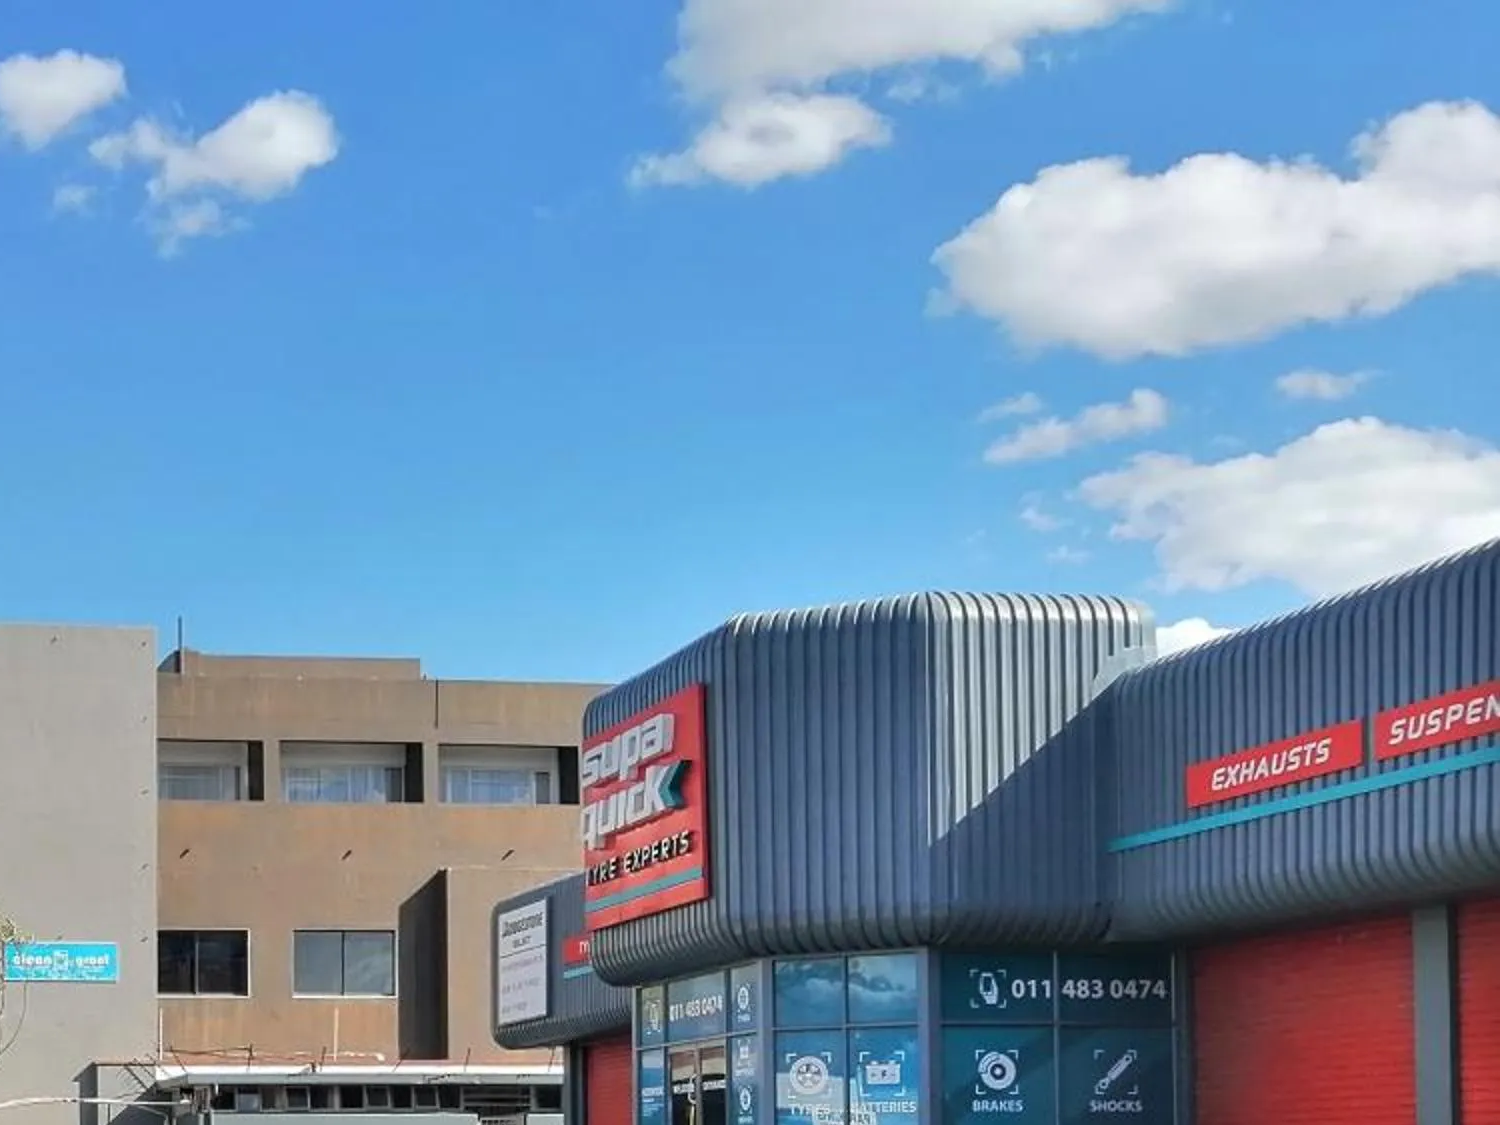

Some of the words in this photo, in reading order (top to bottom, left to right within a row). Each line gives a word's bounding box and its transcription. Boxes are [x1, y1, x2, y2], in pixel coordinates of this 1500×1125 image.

[1388, 694, 1500, 745] SUSPEN
[1210, 737, 1332, 791] EXHAUSTS
[623, 831, 693, 874] EXPERTS
[1011, 977, 1052, 999] 011
[1062, 977, 1104, 999] 483
[1109, 977, 1168, 1000] 0474
[971, 1098, 1024, 1114] BRAKES
[1088, 1098, 1143, 1114] SHOCKS
